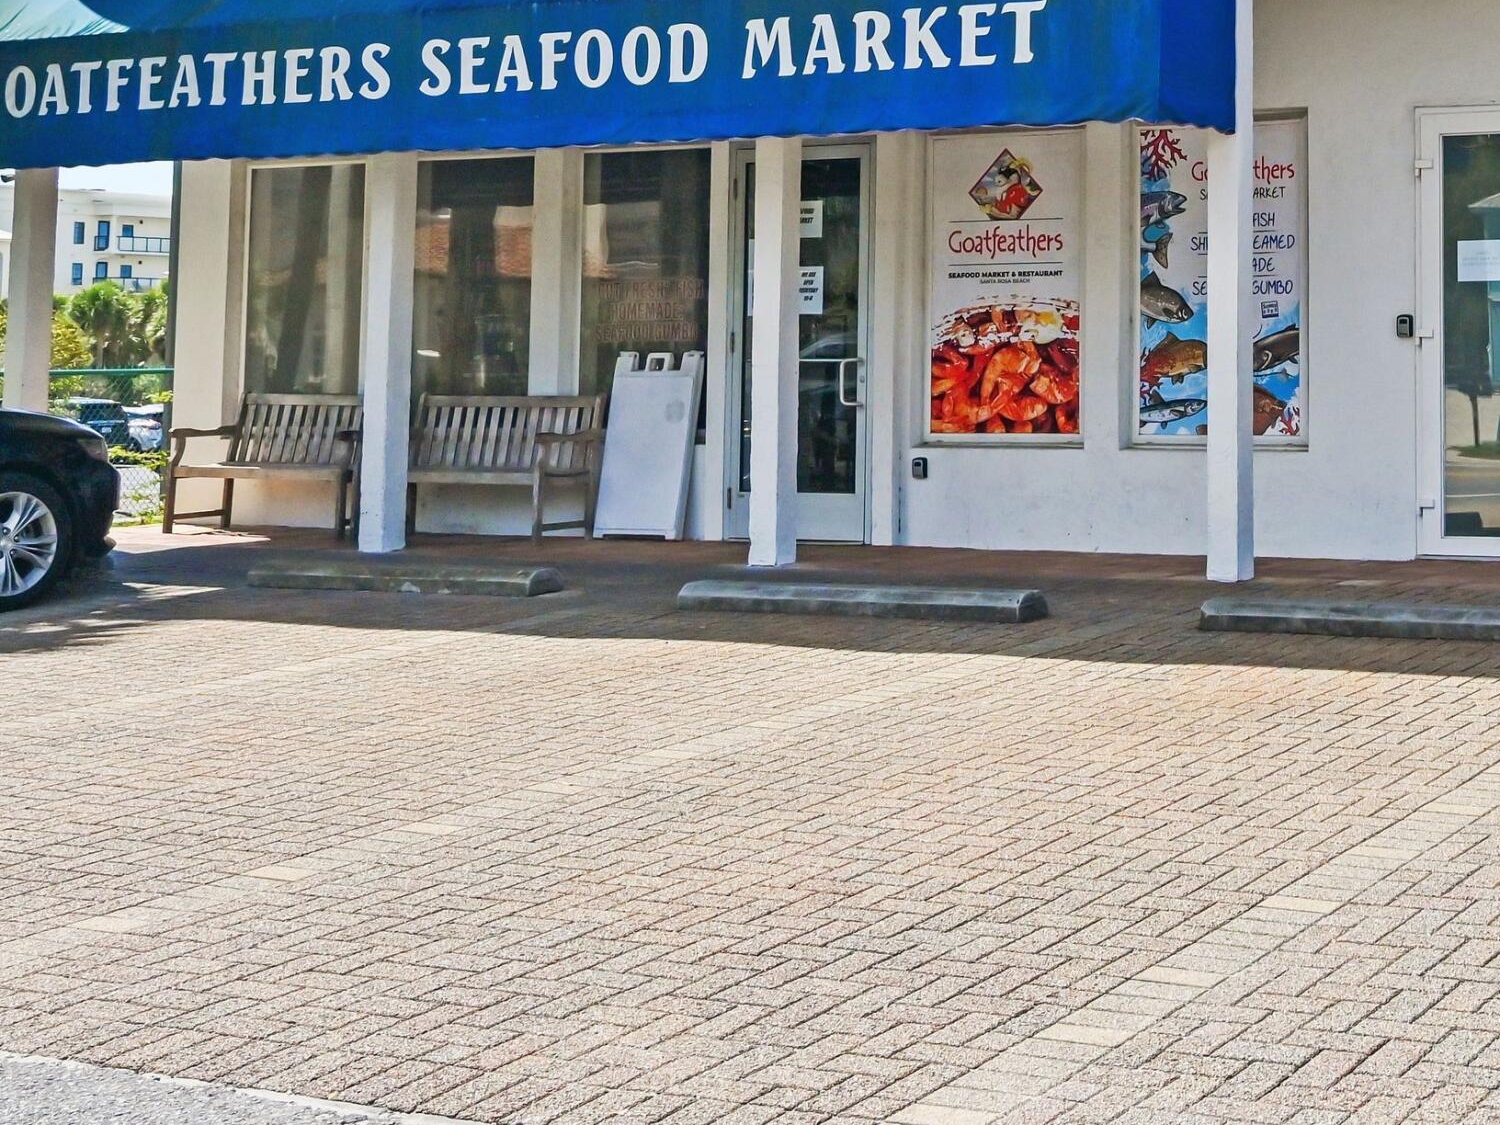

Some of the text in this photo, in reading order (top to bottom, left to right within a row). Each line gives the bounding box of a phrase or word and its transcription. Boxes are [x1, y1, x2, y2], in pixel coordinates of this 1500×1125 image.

[418, 23, 709, 97] SEAFOOD
[741, 0, 1047, 79] MARKET
[1253, 186, 1286, 200] ARKET
[1252, 212, 1275, 227] FISH
[948, 224, 1064, 259] Goatfeathers
